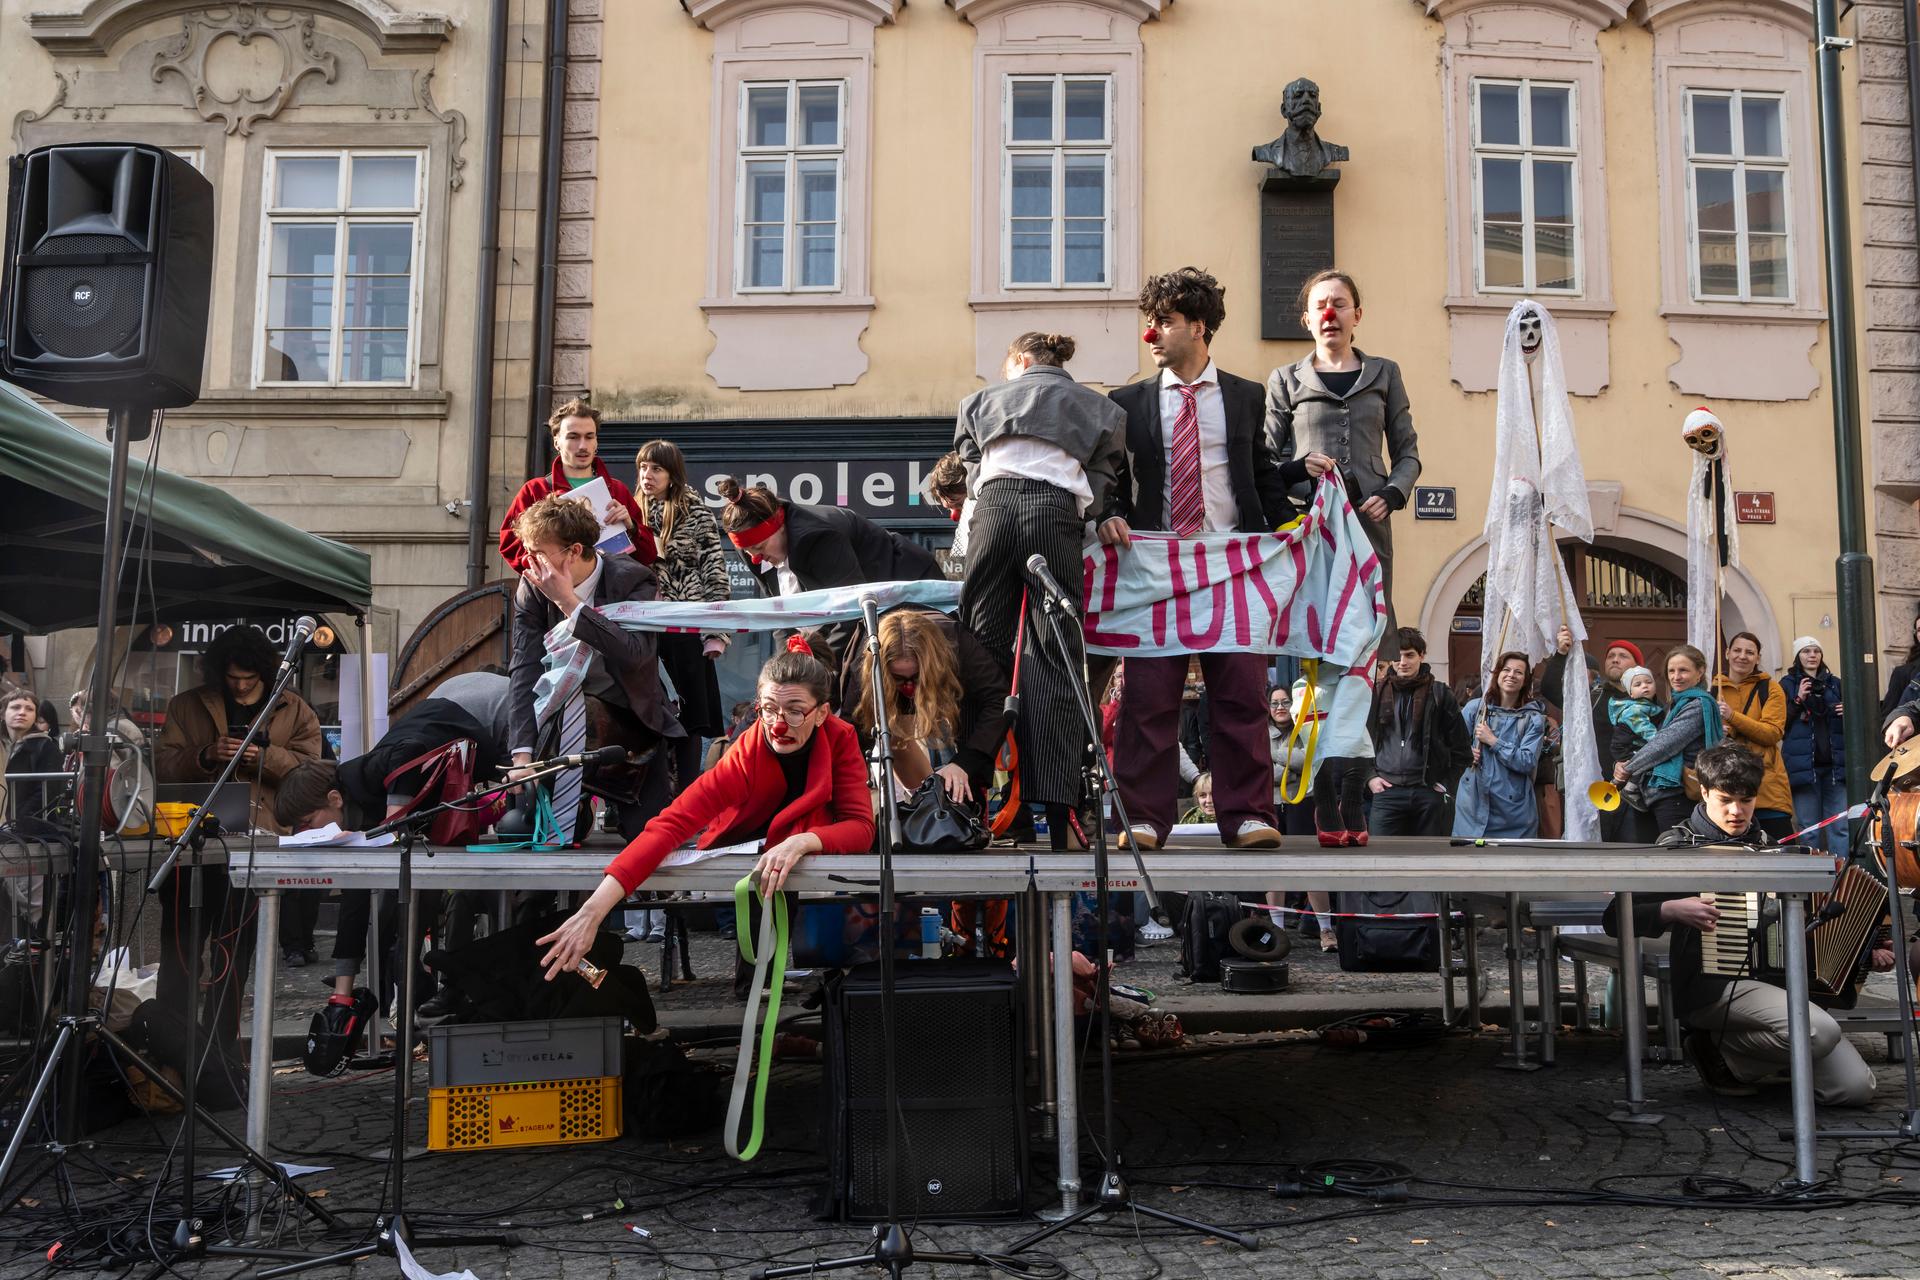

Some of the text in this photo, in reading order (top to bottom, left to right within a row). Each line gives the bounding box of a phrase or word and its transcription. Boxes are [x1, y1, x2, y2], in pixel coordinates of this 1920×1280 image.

[74, 291, 91, 300] RCF
[1427, 492, 1446, 506] 27
[1751, 494, 1761, 508] 4
[943, 560, 964, 573] Na
[182, 617, 313, 644] indi
